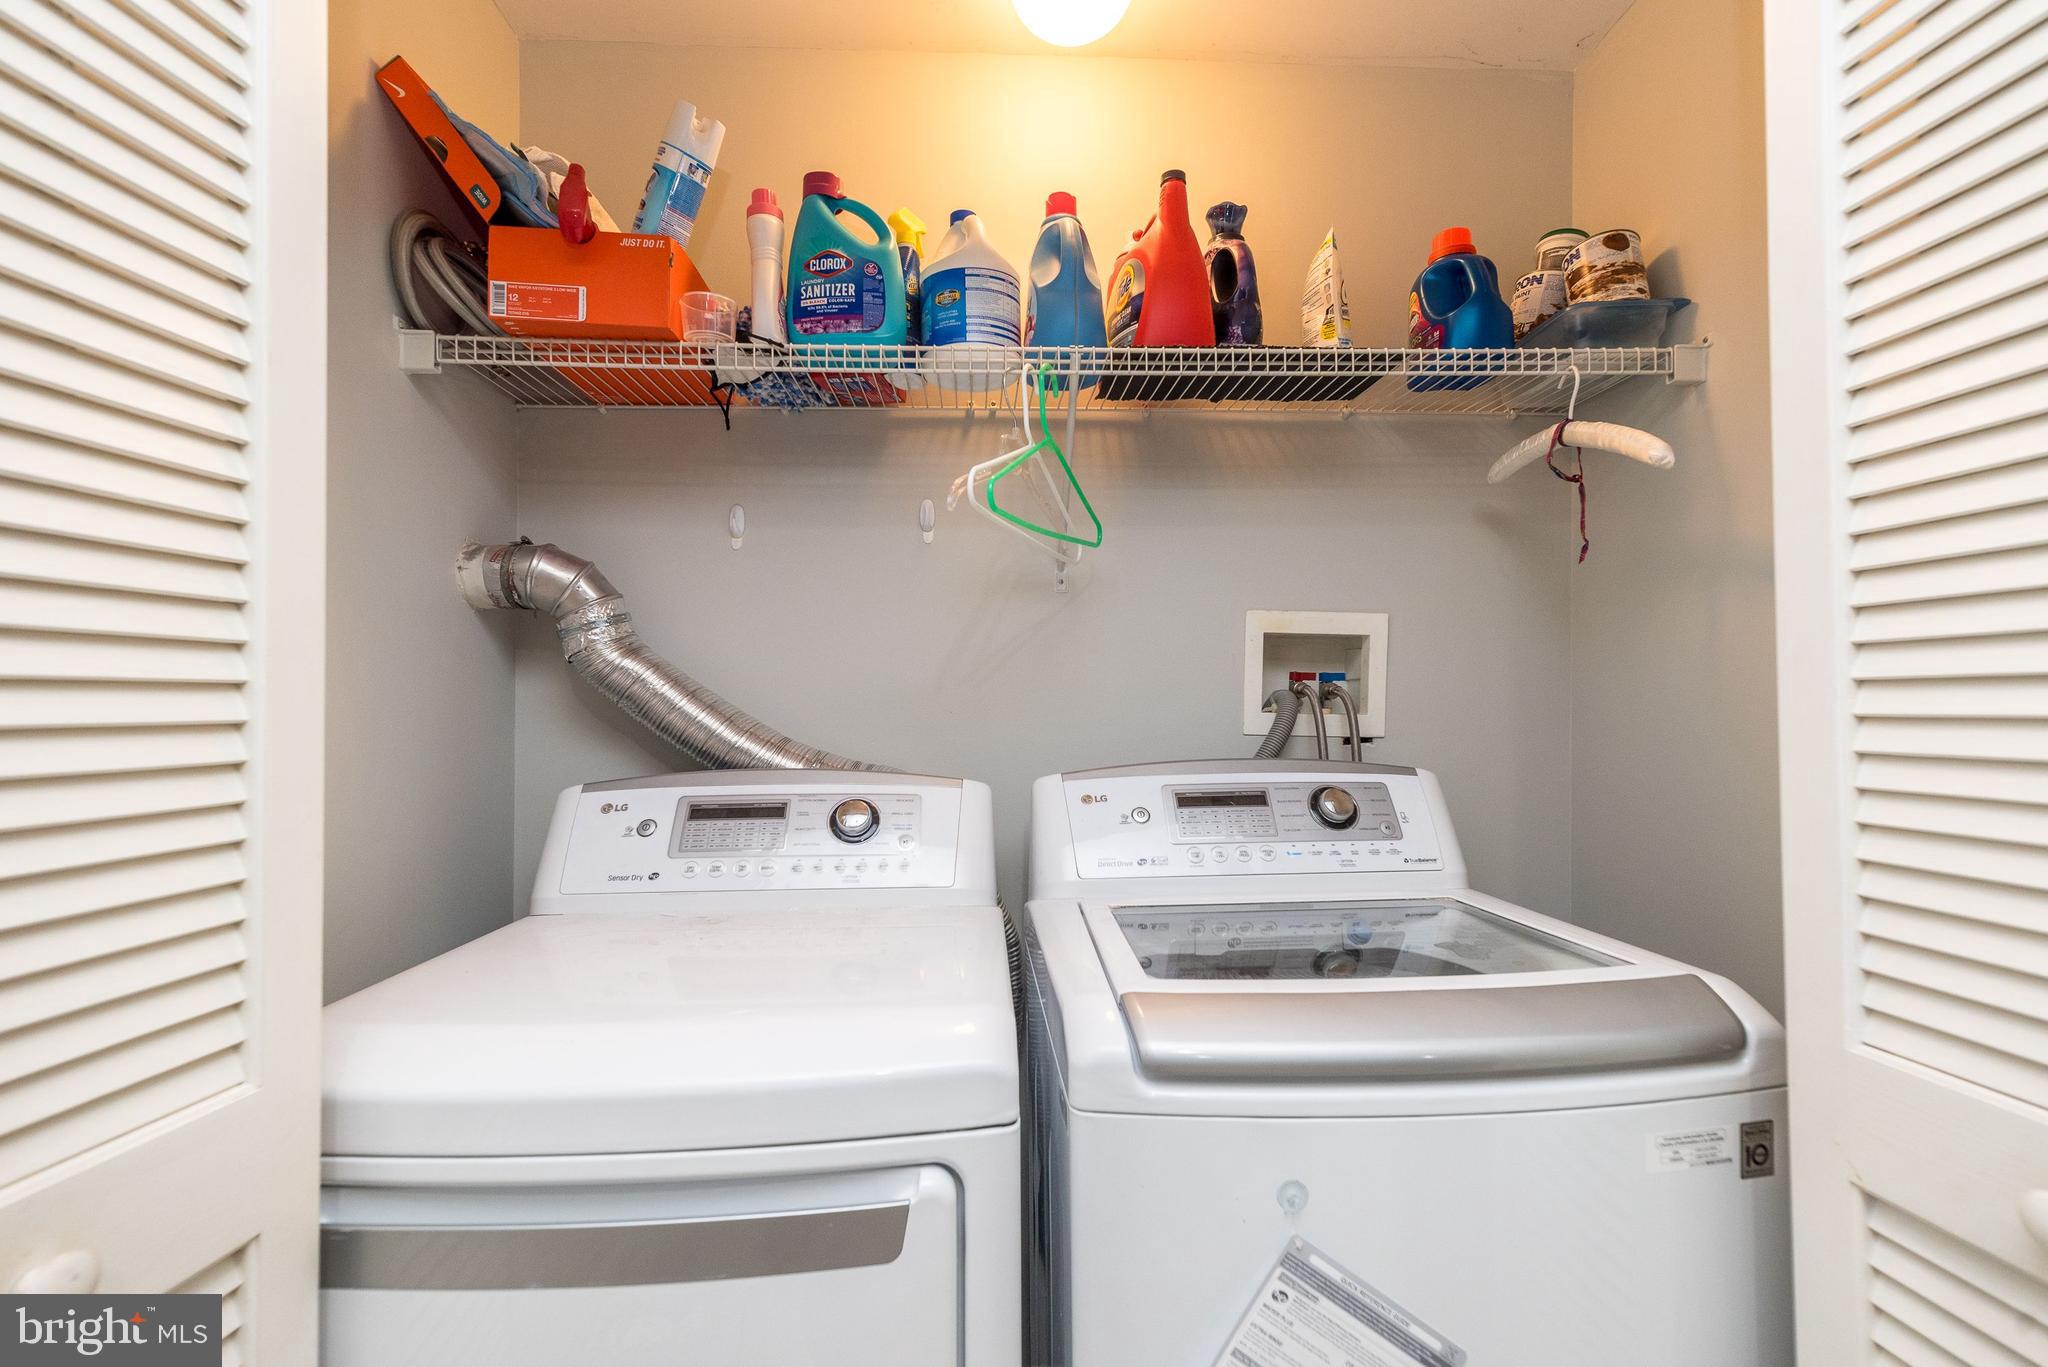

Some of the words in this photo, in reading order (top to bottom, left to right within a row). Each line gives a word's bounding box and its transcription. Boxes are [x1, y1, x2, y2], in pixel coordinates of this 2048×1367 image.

[474, 188, 488, 206] WIDE
[619, 238, 642, 247] JUST
[642, 238, 655, 248] DO
[655, 239, 666, 249] IT.
[809, 257, 847, 271] CLOROX
[800, 278, 825, 286] LAUNDRY
[1119, 275, 1132, 298] Tide
[800, 283, 856, 300] SANITIZER
[507, 293, 519, 302] 12
[1094, 794, 1108, 803] LG
[614, 803, 629, 812] LG
[607, 874, 630, 882] Sensor
[631, 874, 644, 883] Dry
[1745, 1143, 1769, 1168] 10
